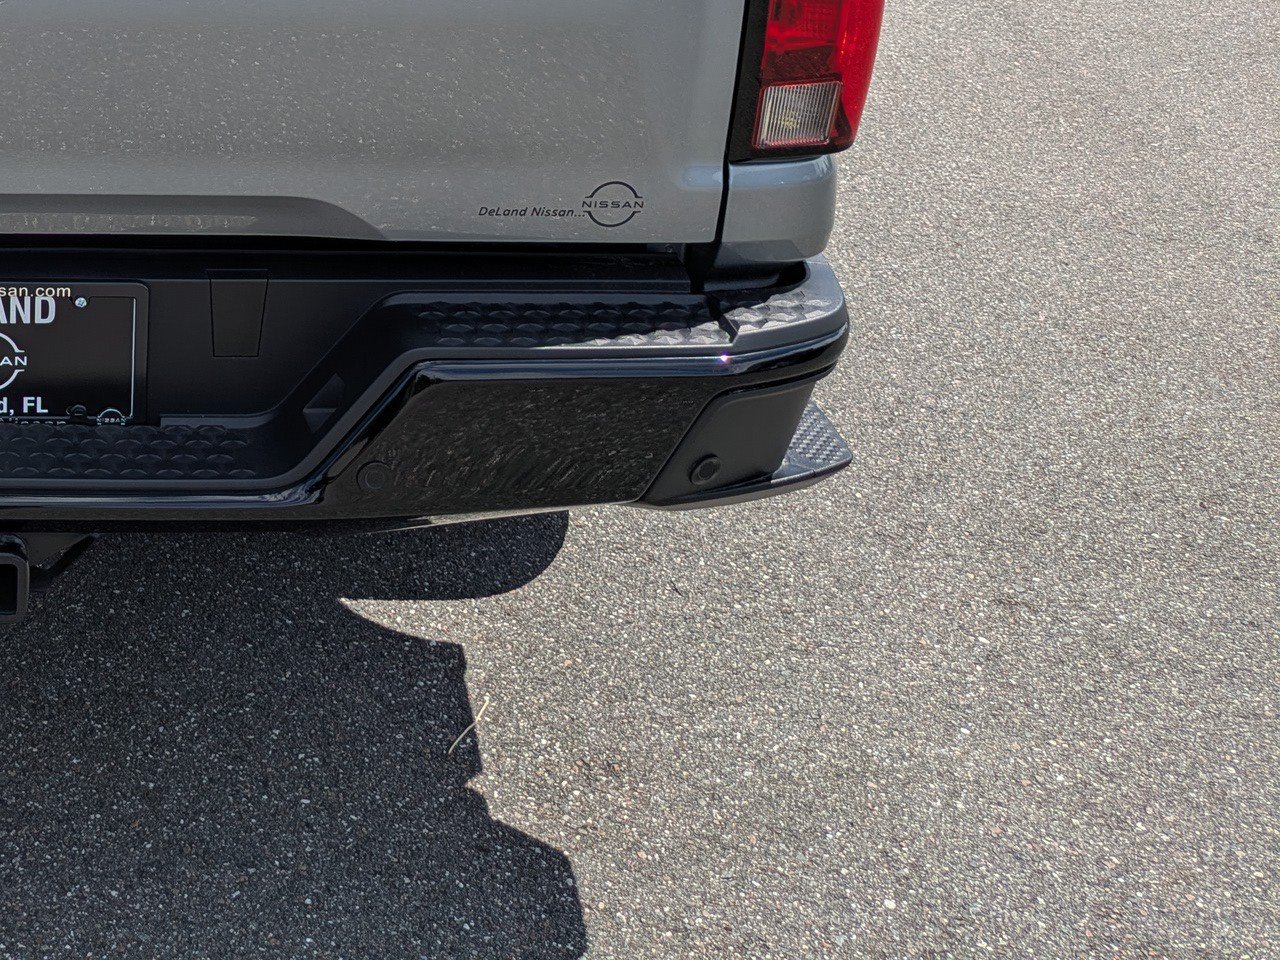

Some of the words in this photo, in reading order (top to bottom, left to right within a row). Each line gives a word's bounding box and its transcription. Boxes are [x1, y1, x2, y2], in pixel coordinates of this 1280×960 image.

[581, 200, 645, 209] NISSAN
[478, 206, 528, 217] DeLand
[22, 396, 49, 414] FL
